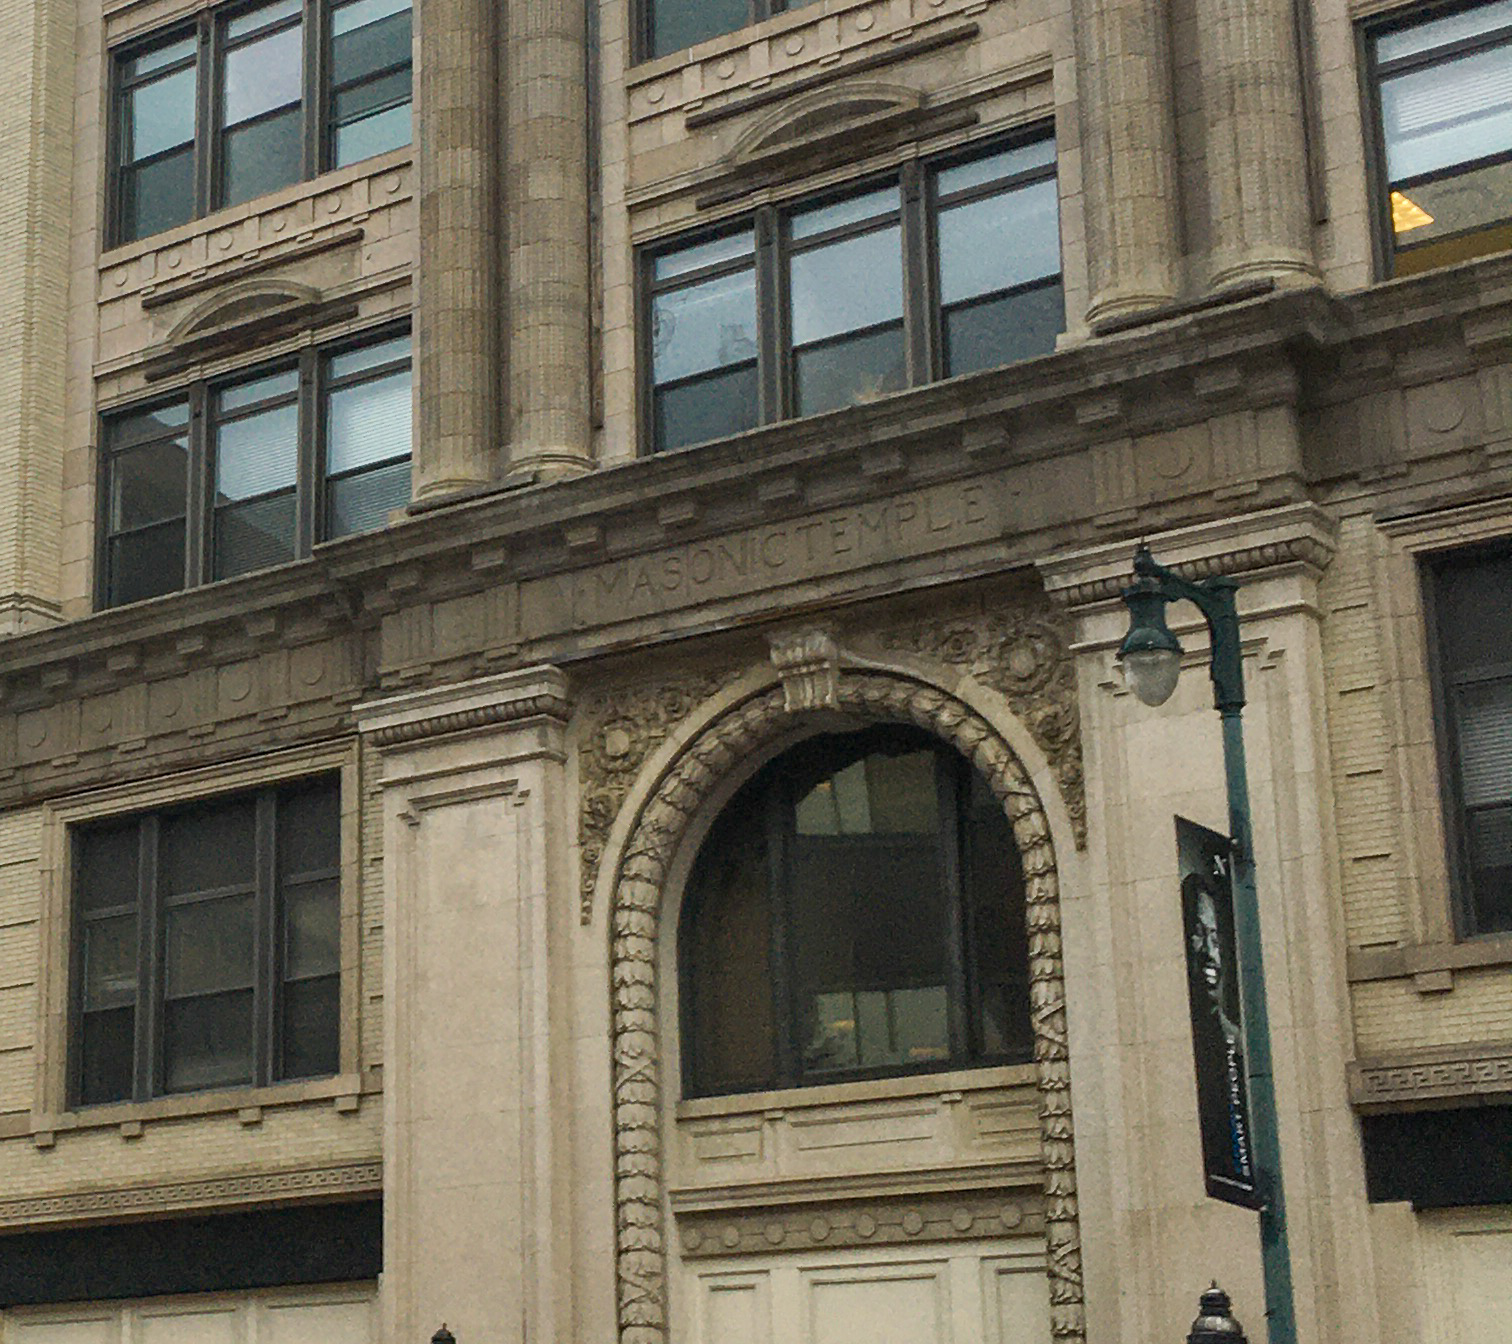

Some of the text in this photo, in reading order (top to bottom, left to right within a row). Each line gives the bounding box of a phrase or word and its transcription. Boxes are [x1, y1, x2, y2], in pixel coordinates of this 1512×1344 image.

[593, 484, 986, 603] MASONIC TEMPLE
[1226, 1034, 1240, 1105] PEOPLE
[1235, 1113, 1250, 1176] SMART
